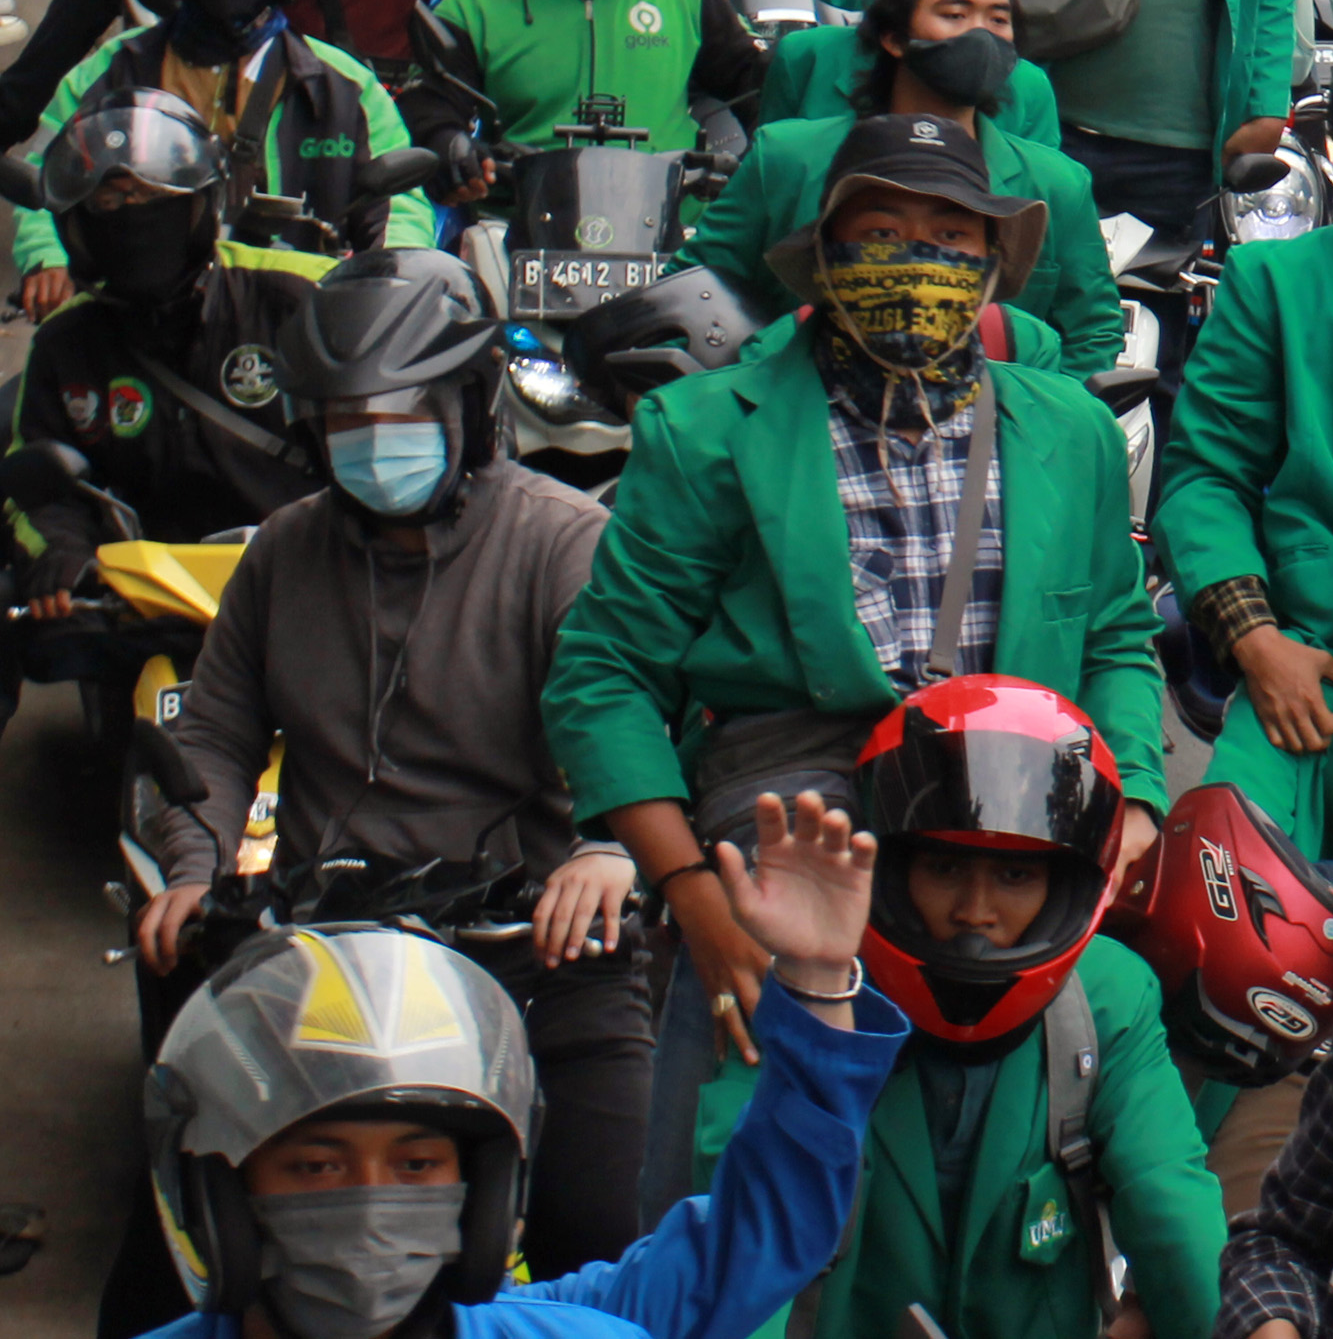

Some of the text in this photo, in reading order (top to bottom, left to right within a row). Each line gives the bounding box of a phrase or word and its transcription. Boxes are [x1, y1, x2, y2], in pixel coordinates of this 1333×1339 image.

[625, 35, 670, 50] gojek
[299, 133, 356, 158] Grab
[526, 260, 540, 285] B
[163, 691, 183, 720] B
[321, 858, 367, 871] HONDA
